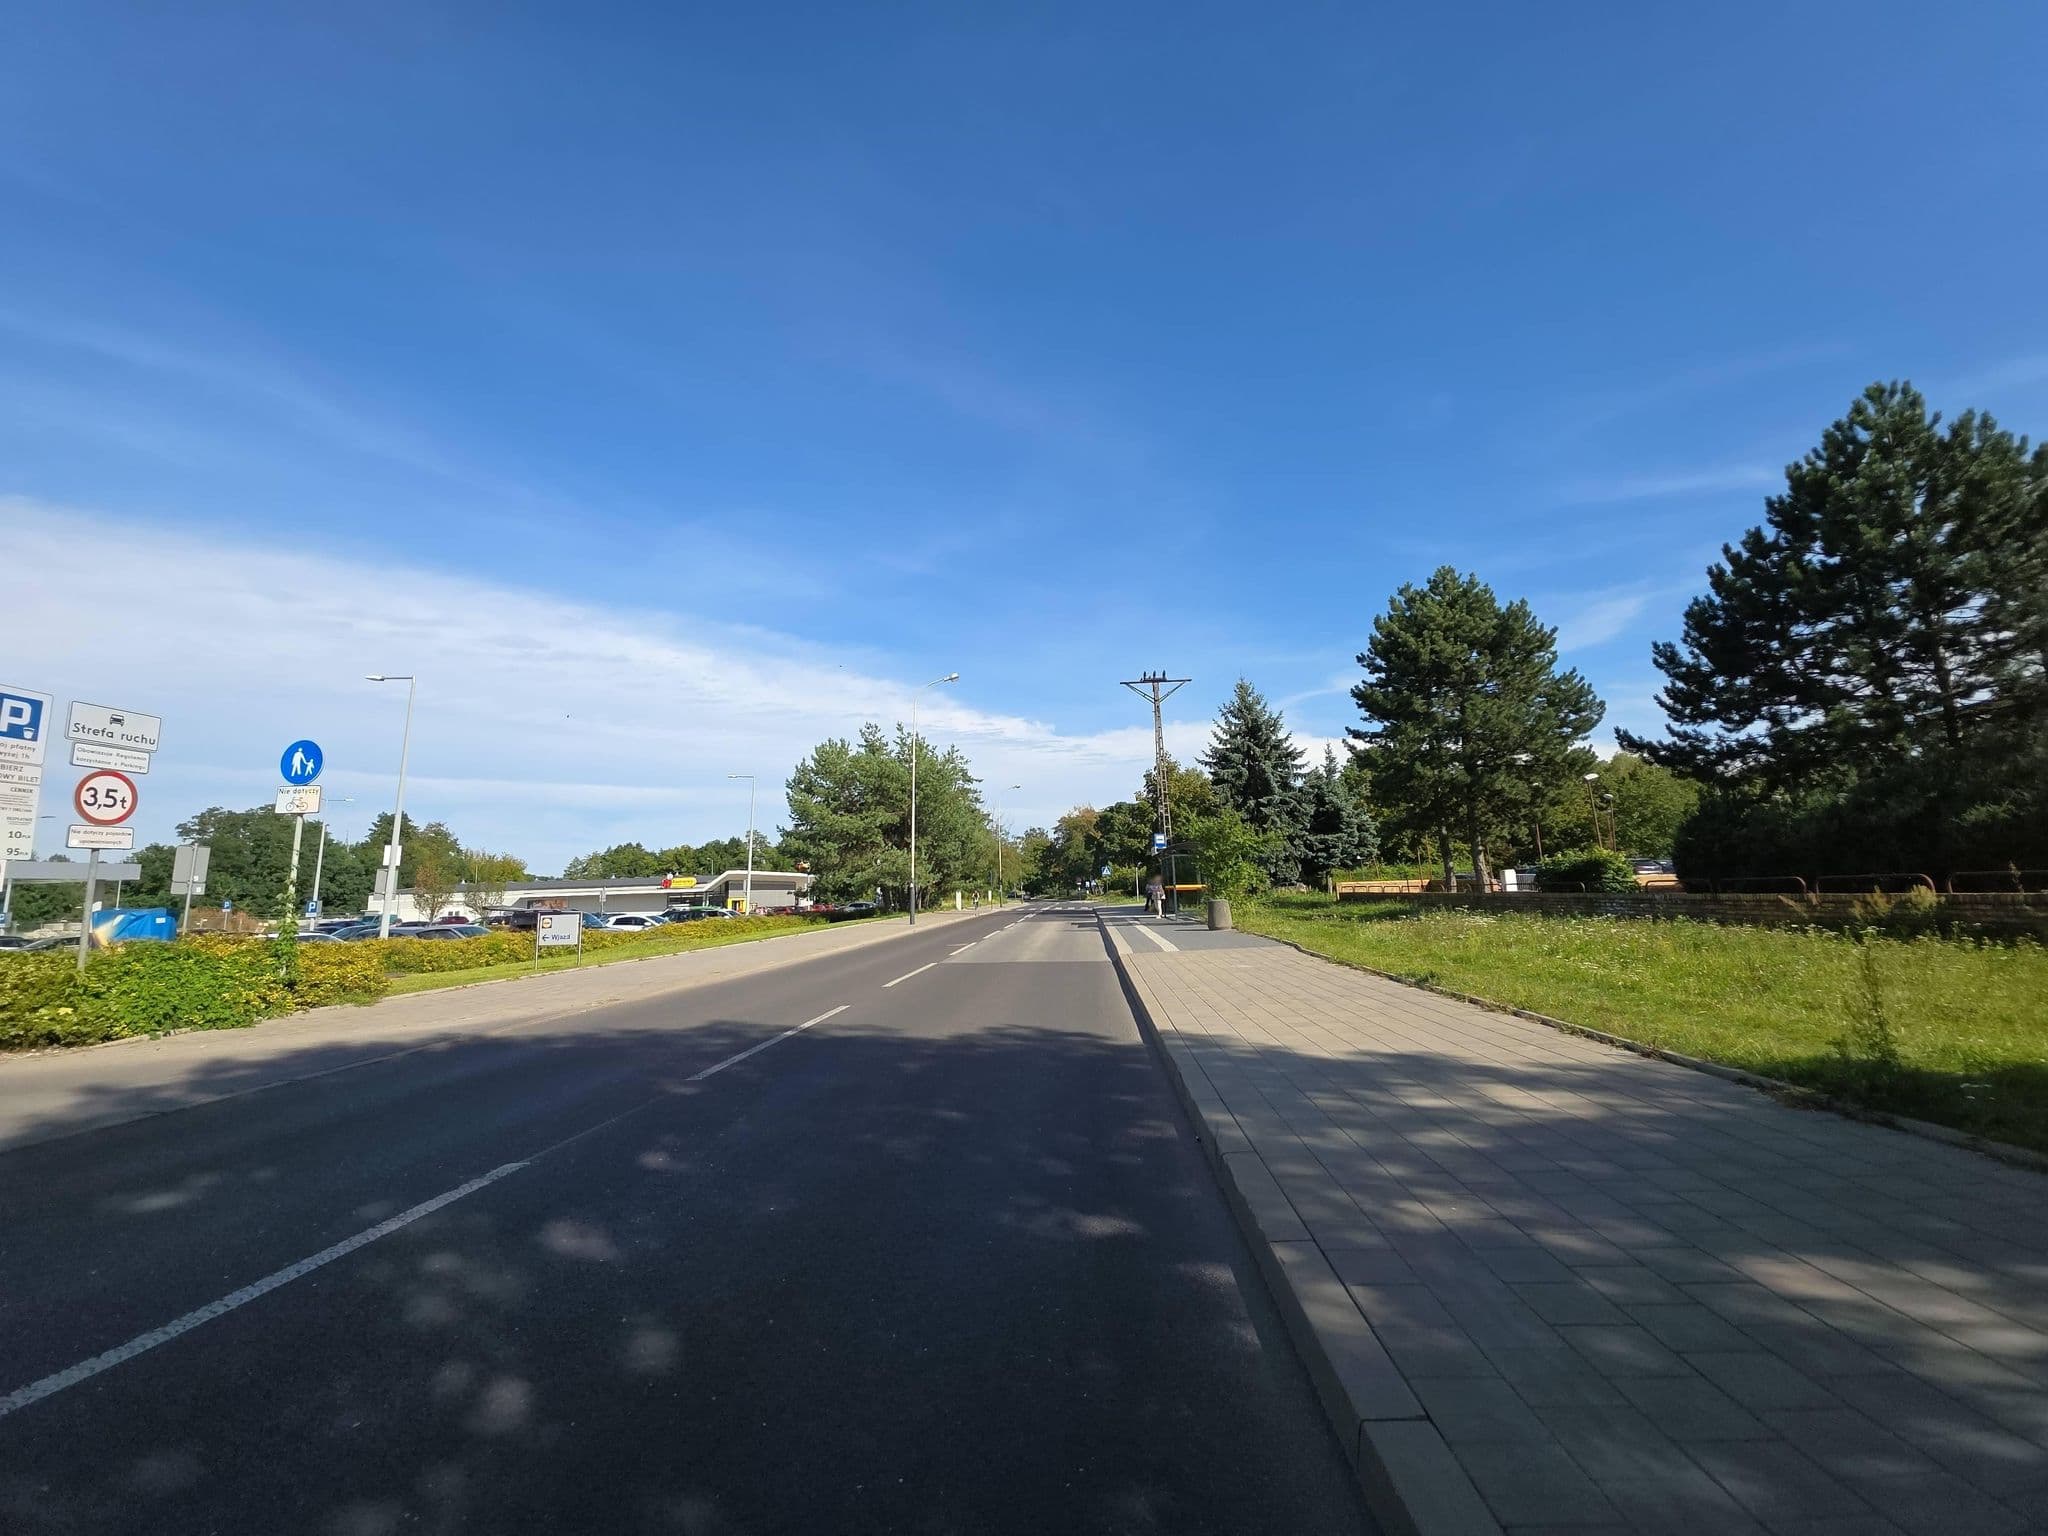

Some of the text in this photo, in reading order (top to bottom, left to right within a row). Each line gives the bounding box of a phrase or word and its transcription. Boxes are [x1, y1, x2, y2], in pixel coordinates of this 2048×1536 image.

[0, 698, 31, 732] P
[72, 722, 156, 745] Strefa ruchu
[18, 775, 40, 783] BILET
[293, 787, 319, 795] dotyczy
